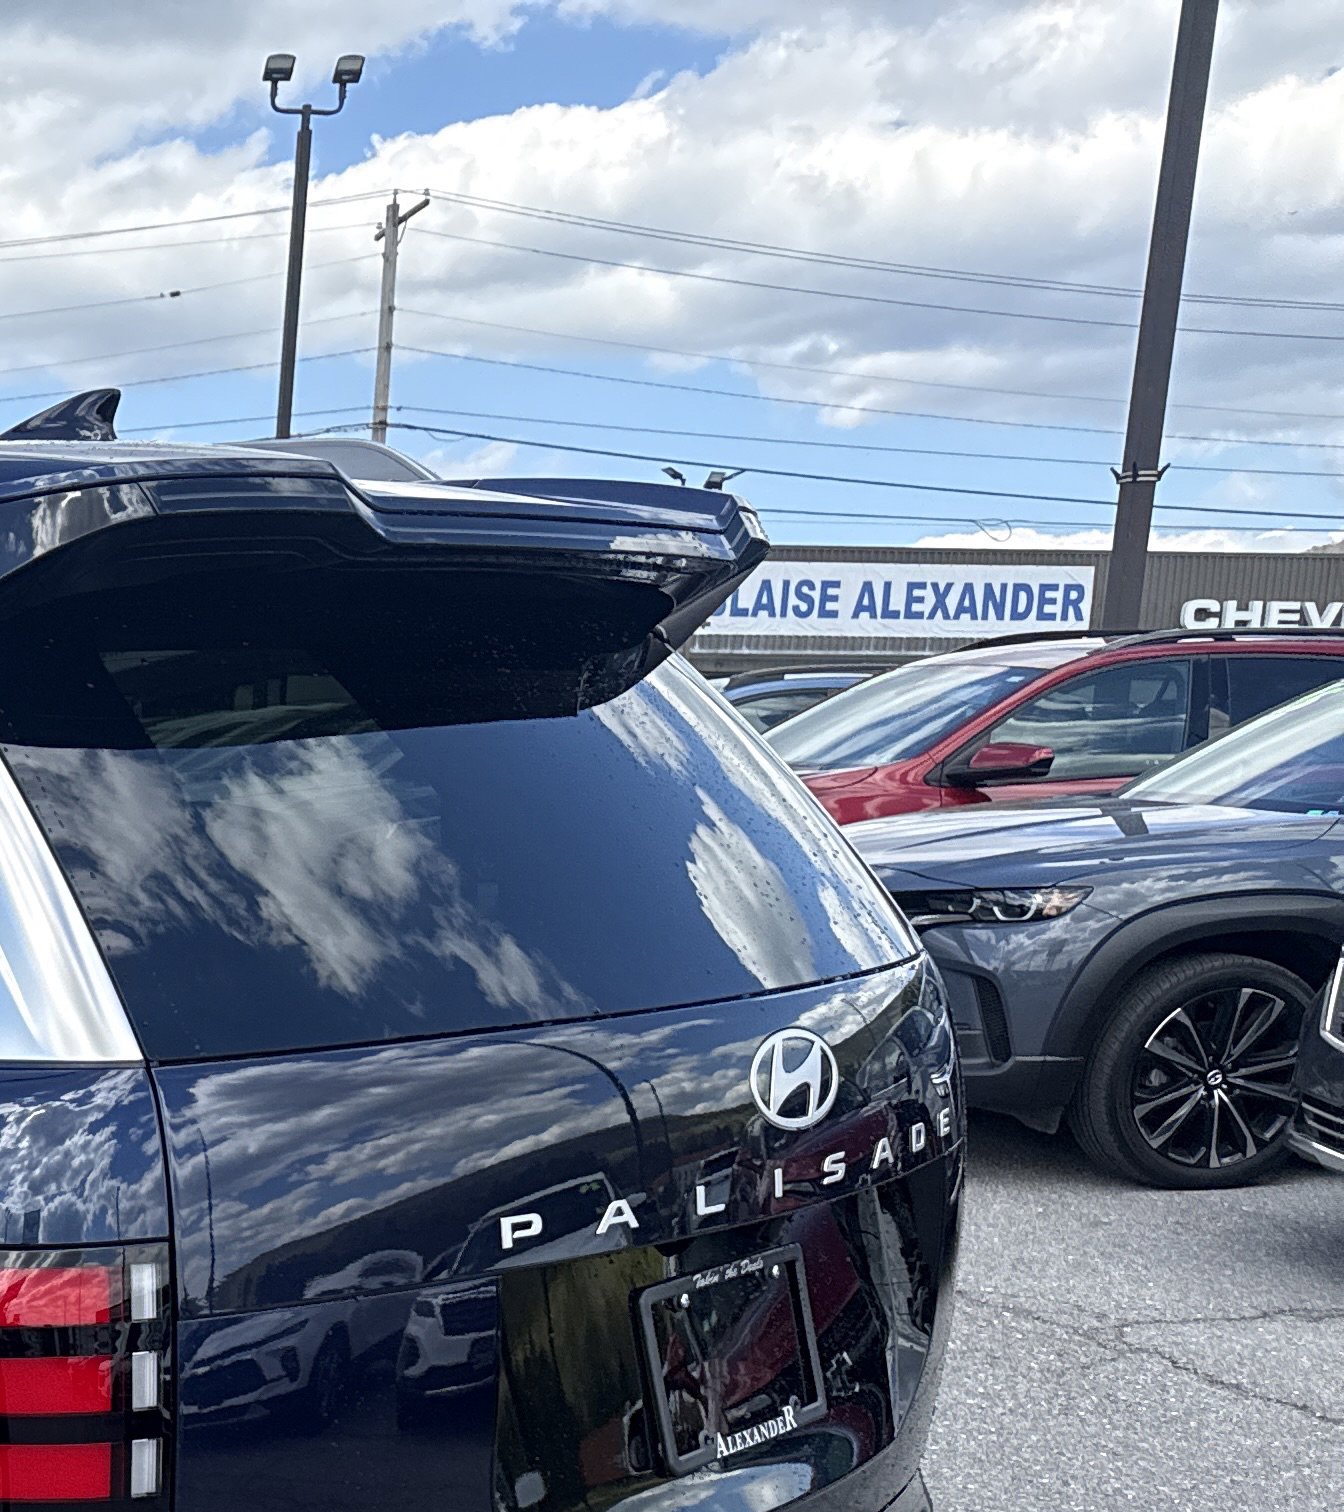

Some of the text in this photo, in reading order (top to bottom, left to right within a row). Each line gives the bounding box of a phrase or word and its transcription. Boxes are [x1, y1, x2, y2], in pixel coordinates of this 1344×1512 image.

[850, 580, 1086, 622] ALEXANDER
[1179, 599, 1344, 630] CHEV
[499, 1105, 952, 1250] PALISADE
[716, 1405, 798, 1459] ALEXANDER
